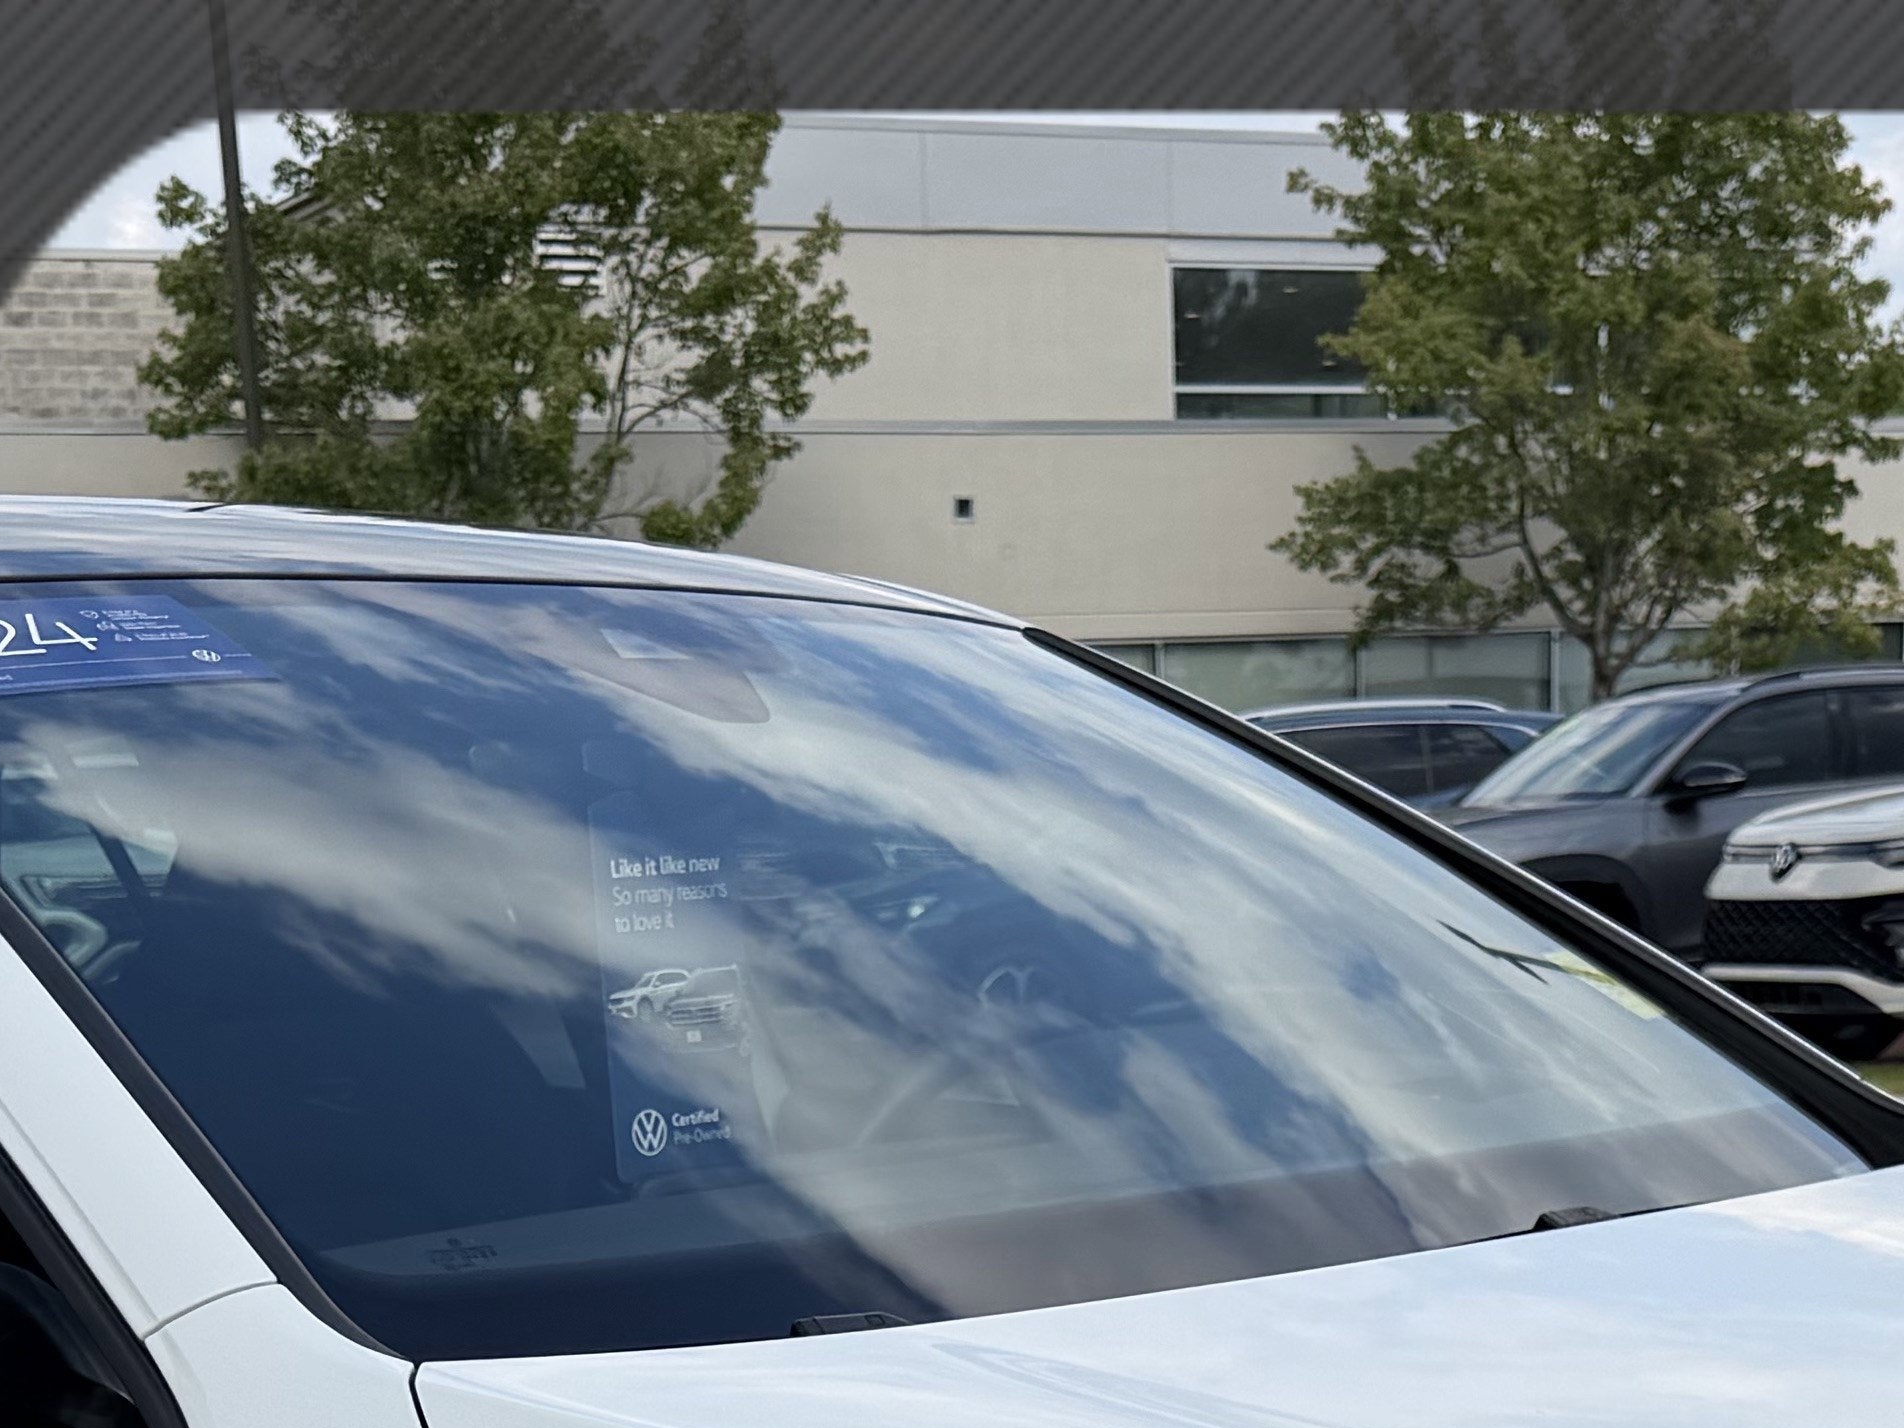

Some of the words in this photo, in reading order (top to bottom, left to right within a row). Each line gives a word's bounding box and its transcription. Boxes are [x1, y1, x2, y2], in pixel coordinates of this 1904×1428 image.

[610, 858, 642, 879] Like
[644, 857, 657, 876] it
[612, 886, 632, 906] So
